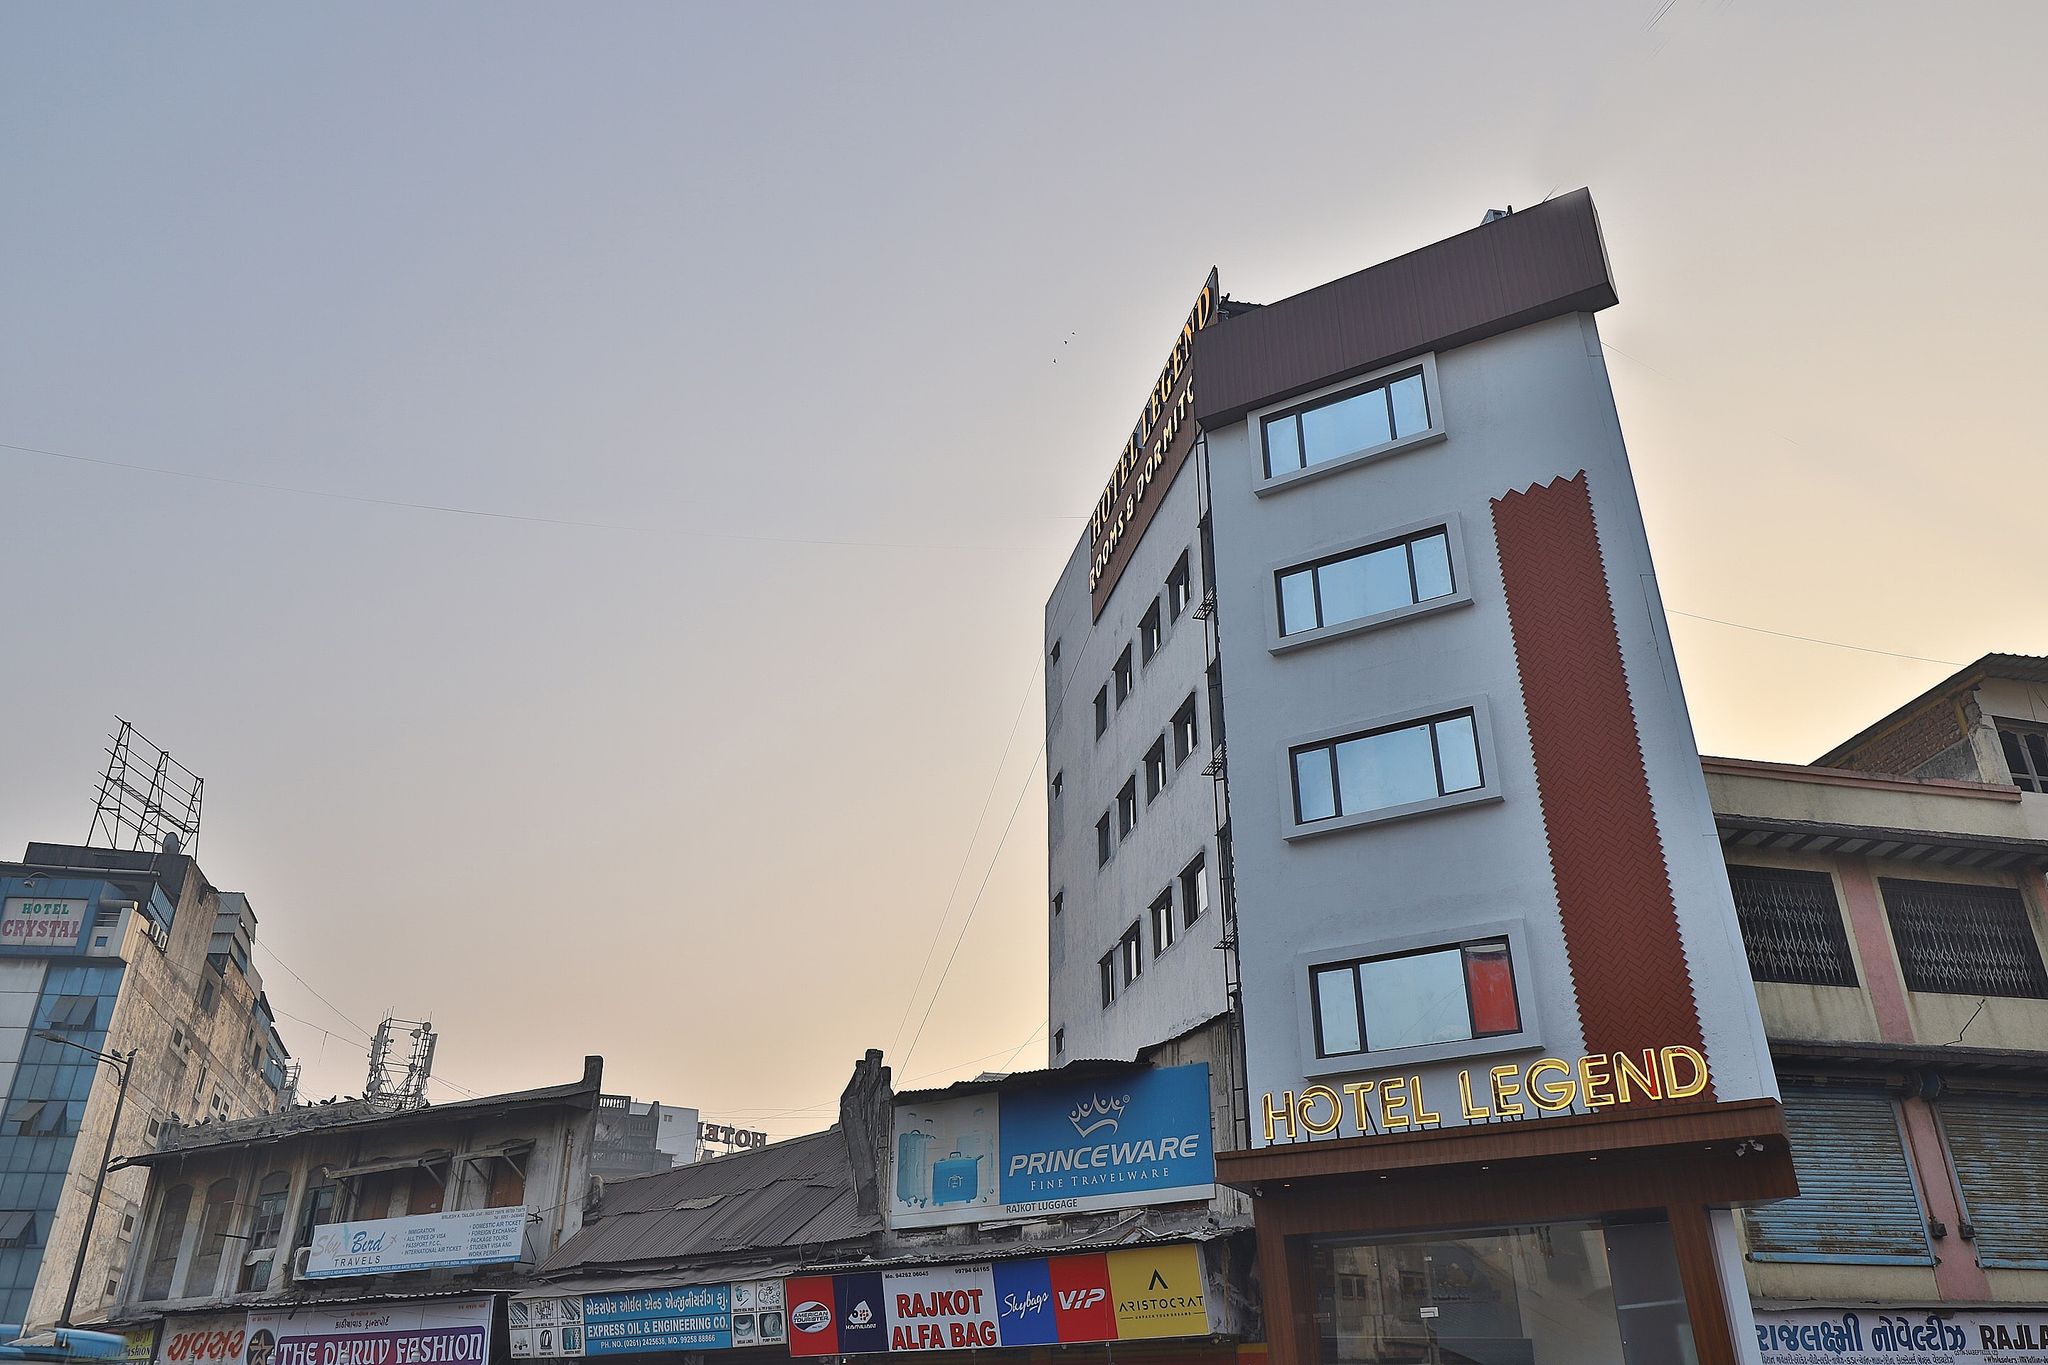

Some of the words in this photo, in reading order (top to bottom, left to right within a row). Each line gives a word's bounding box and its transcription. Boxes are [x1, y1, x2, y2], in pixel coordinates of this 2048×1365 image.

[1092, 430, 1138, 546] HOTEL
[1140, 286, 1210, 449] LEGEND
[1089, 511, 1124, 594] ROOMS
[22, 903, 69, 914] HOTEL
[2, 920, 80, 938] CRYSTAL
[1262, 1074, 1440, 1140] HOTEL
[1458, 1045, 1708, 1120] LEGEND
[1008, 1134, 1200, 1177] PRINCEWARE
[1030, 1178, 1064, 1191] FINE
[1071, 1167, 1170, 1187] TRAVELWARE
[1006, 1203, 1036, 1214] RAJKOT
[1038, 1198, 1078, 1211] LUGGAGE
[311, 1233, 342, 1260] Sky
[351, 1230, 386, 1253] Bird
[334, 1255, 381, 1267] TRAVELS
[896, 1288, 984, 1319] RAJKOT
[1000, 1290, 1050, 1319] Skybags
[1057, 1287, 1106, 1311] VIP
[1118, 1295, 1204, 1313] ARISTOCRAT
[587, 1324, 625, 1337] EXPRESS
[627, 1322, 641, 1335] OIL
[643, 1321, 651, 1333] &
[652, 1316, 711, 1333] ENGINEERING
[713, 1315, 728, 1329] CO.
[793, 1310, 829, 1319] AMERICAN
[600, 1340, 611, 1348] PH.
[611, 1340, 623, 1348] NO.
[668, 1336, 680, 1344] MO.
[892, 1324, 947, 1351] ALFA
[950, 1320, 997, 1347] BAG
[280, 1342, 319, 1365] THE
[324, 1339, 391, 1365] DHRUV
[395, 1333, 483, 1365] FASHION
